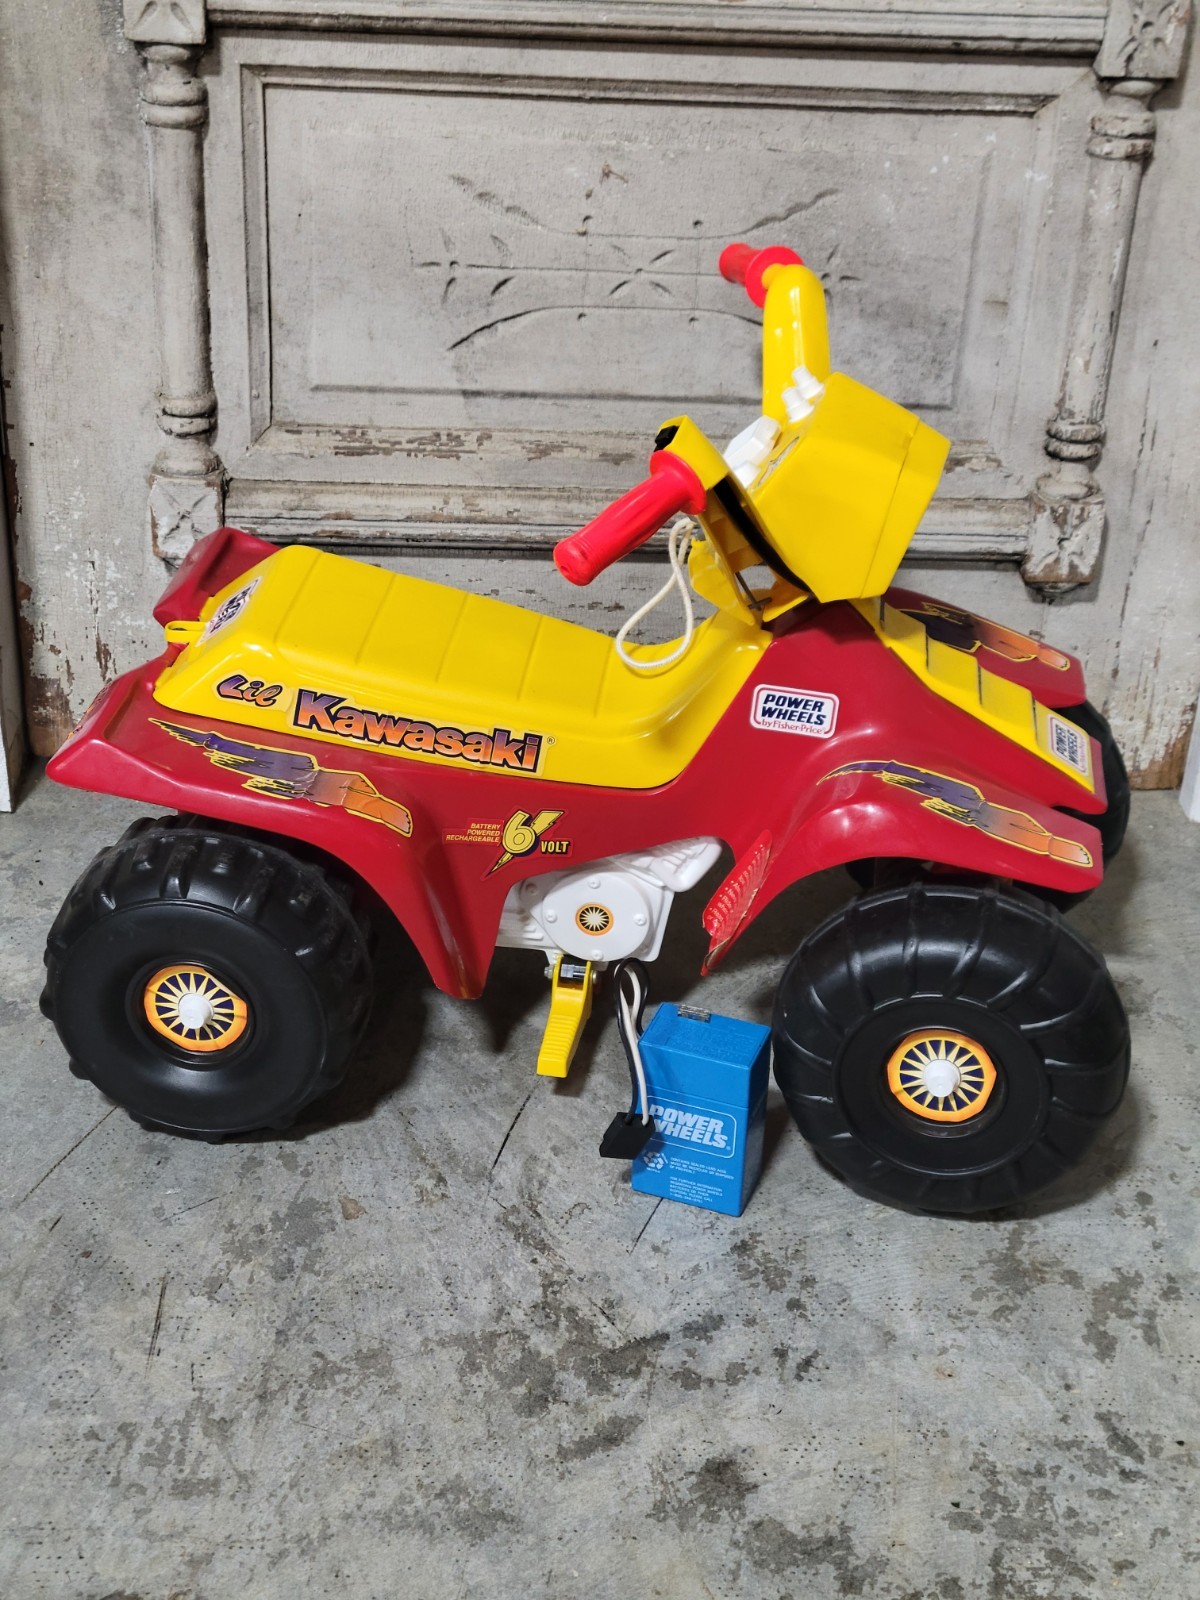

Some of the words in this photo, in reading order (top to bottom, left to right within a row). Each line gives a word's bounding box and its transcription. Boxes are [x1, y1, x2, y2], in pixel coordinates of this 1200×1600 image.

[763, 693, 824, 712] POWER
[216, 674, 283, 707] Lil
[293, 688, 543, 773] Kawasaki
[761, 706, 827, 726] WHEELS
[761, 719, 773, 728] by
[466, 829, 501, 837] POWERED
[470, 822, 502, 831] BATTERY
[501, 809, 540, 857] 6
[541, 840, 570, 855] VOLT
[446, 834, 501, 843] RECHARGEABLE
[649, 1104, 724, 1134] POWER
